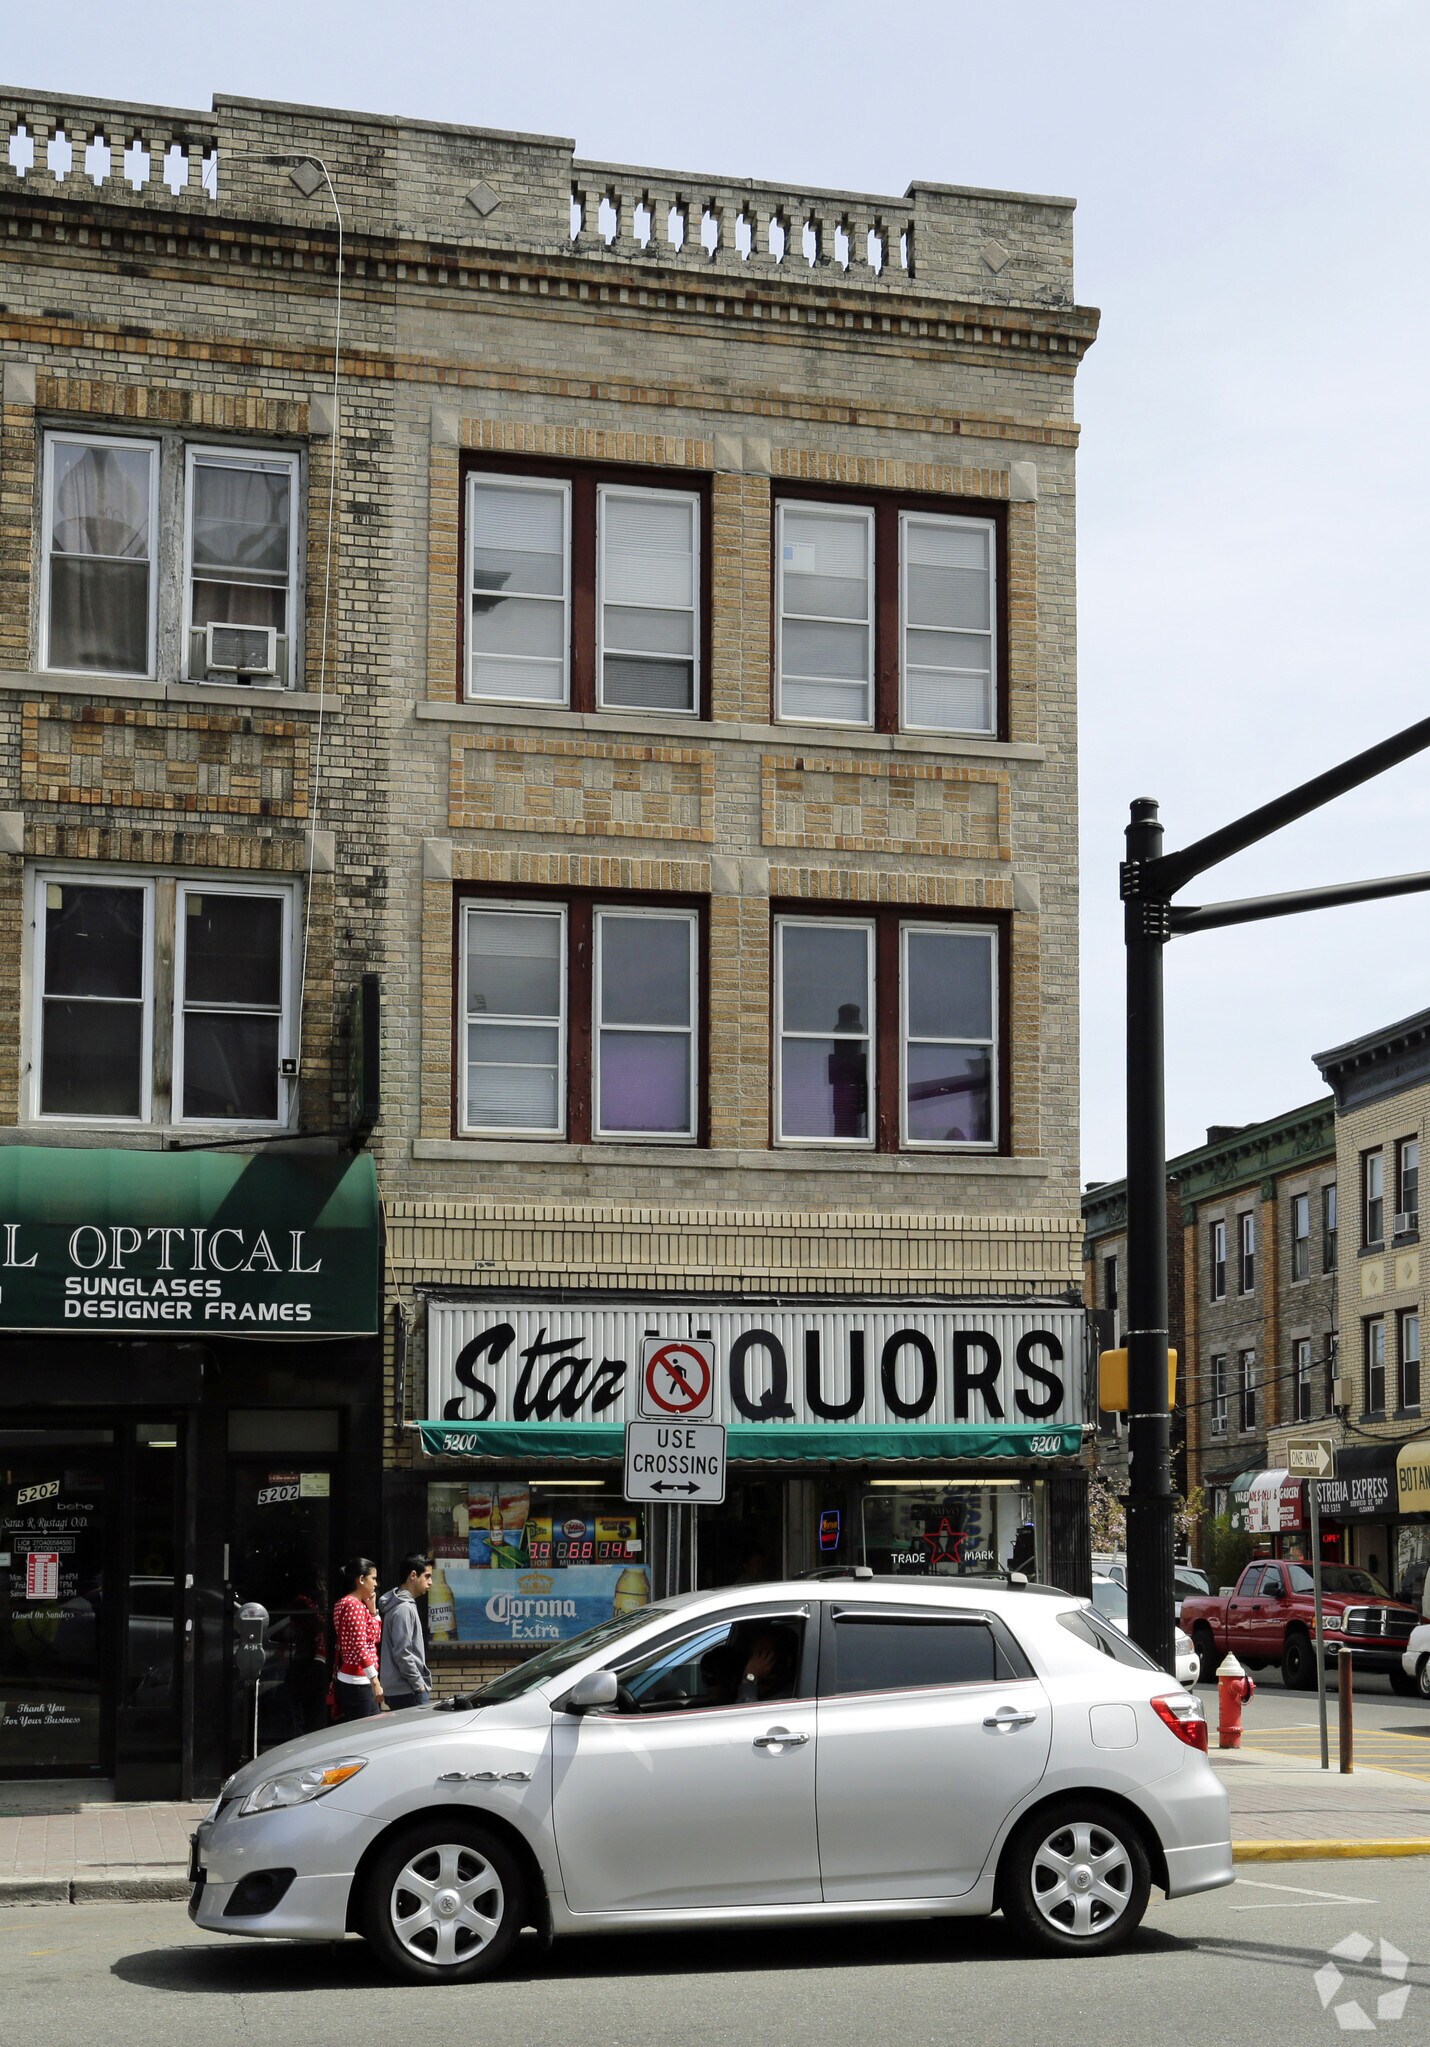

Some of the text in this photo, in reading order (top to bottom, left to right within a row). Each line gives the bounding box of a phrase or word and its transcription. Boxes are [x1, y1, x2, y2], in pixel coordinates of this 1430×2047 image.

[68, 1225, 322, 1273] OPTICAL
[65, 1276, 222, 1298] SUNGLASES
[64, 1299, 311, 1321] DESIGNER FRAMES
[443, 1322, 1065, 1422] Star QUORS
[443, 1433, 478, 1451] 5200
[657, 1429, 697, 1450] USE
[1030, 1434, 1062, 1453] 5200
[633, 1454, 719, 1476] CROSSING
[1291, 1451, 1318, 1466] ONE WAY
[1399, 1465, 1430, 1492] BOTAN
[19, 1482, 58, 1503] 5202
[259, 1486, 298, 1503] 5202
[1307, 1477, 1388, 1503] STRERIA EXPRESS
[57, 1502, 94, 1511] bebe
[1350, 1500, 1367, 1508] SERVICIO
[1375, 1498, 1384, 1506] DRY
[38, 1517, 68, 1531] Rustagi
[71, 1516, 88, 1528] O.D.
[1322, 1533, 1339, 1543] OPE
[891, 1550, 994, 1564] TRADE MARK
[12, 1610, 75, 1620] Closed On Sundays
[485, 1593, 577, 1626] Corona
[511, 1619, 560, 1638] Extra
[17, 1703, 66, 1714] Thank You
[3, 1715, 81, 1727] For Your Business
